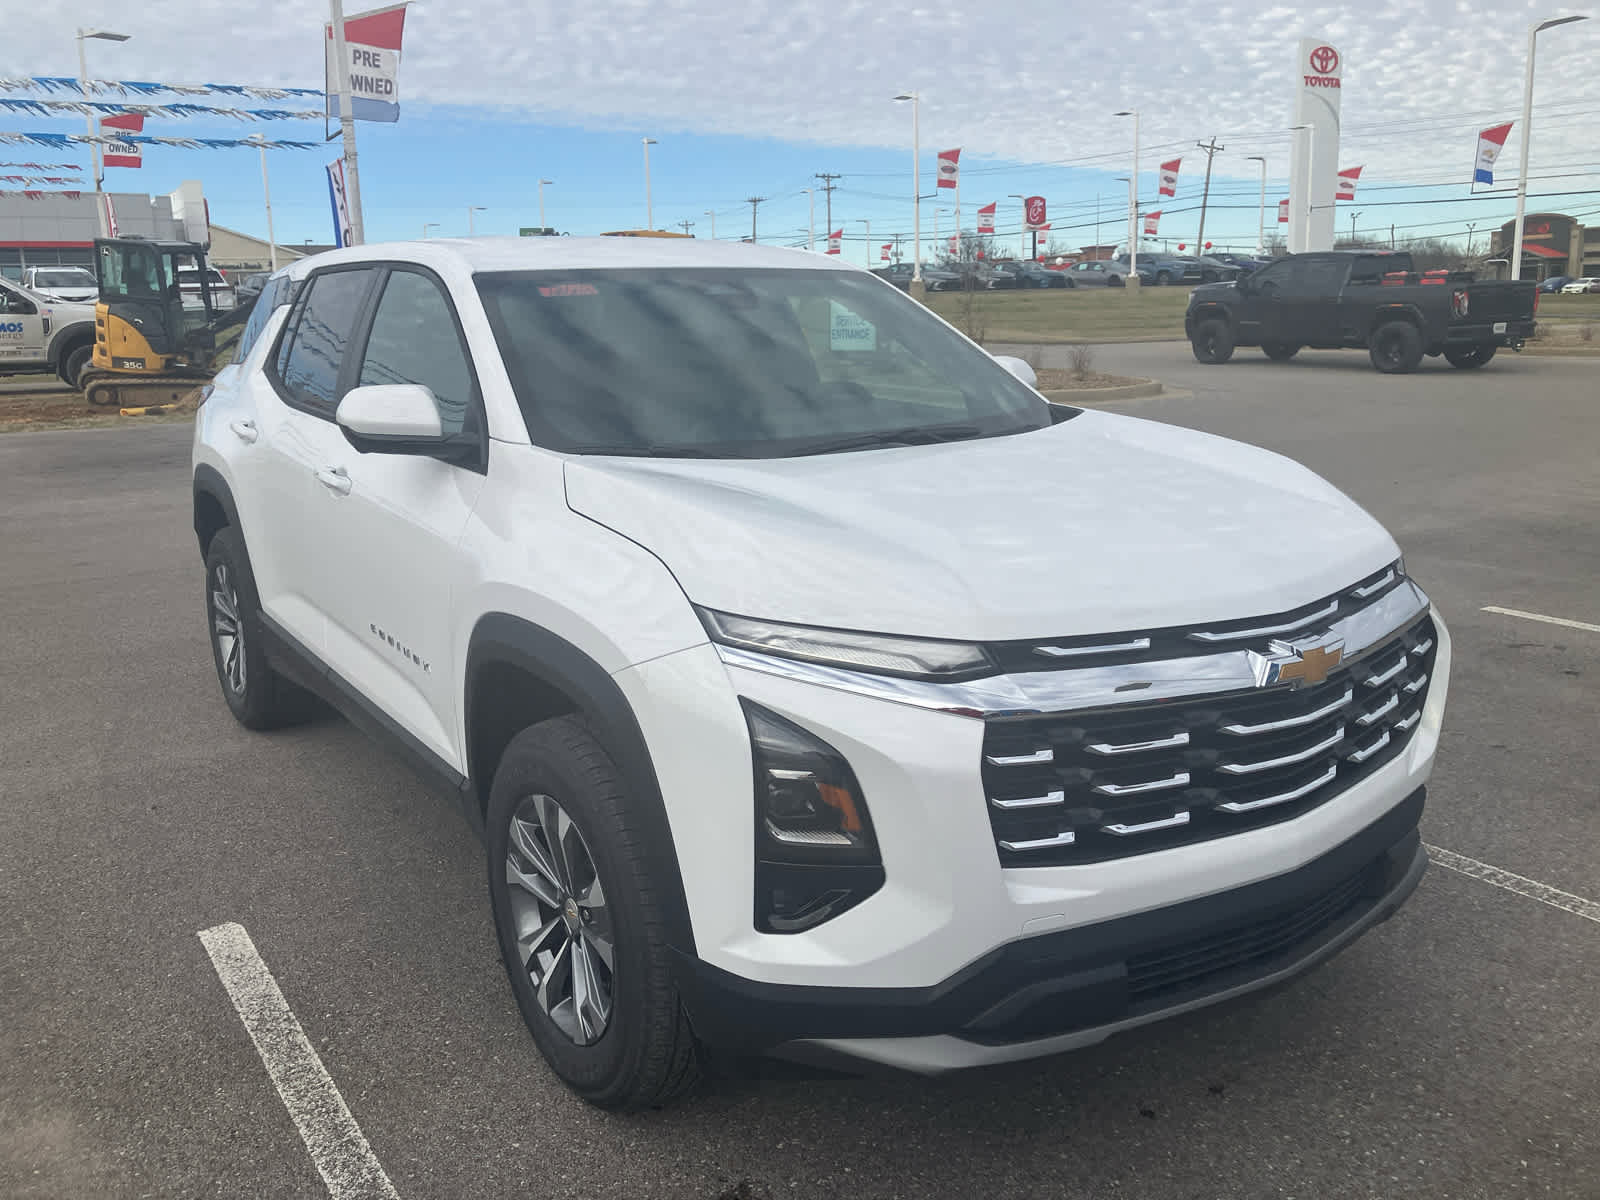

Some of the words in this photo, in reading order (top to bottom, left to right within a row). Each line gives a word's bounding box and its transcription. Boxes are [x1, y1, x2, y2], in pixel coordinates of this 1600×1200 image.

[352, 49, 380, 68] PRE
[350, 74, 393, 95] WNED
[1303, 75, 1341, 88] TOYOTA
[108, 143, 138, 153] OWNED
